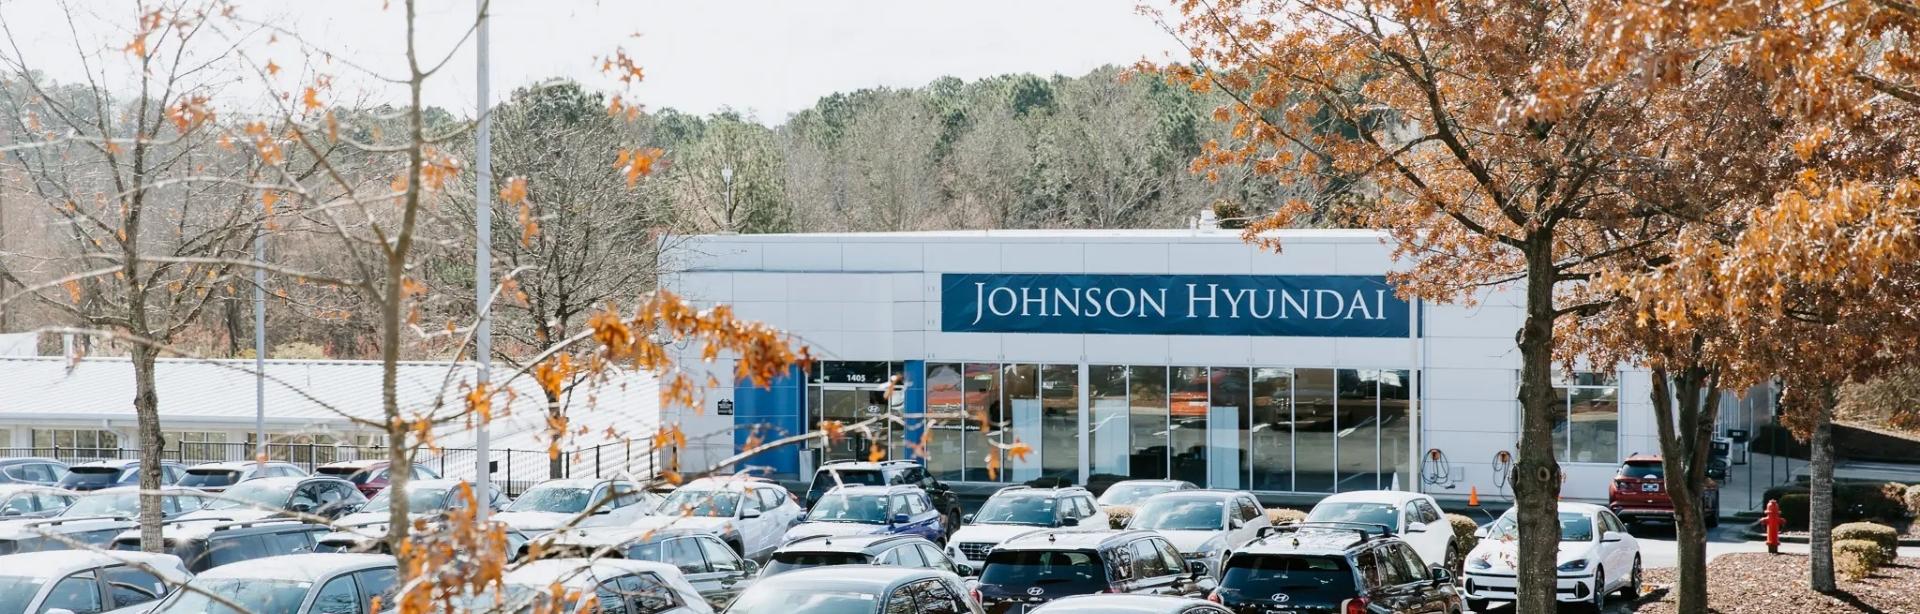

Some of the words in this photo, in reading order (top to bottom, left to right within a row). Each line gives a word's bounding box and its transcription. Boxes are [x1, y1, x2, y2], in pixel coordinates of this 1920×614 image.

[972, 282, 1168, 326] JOHNSON
[1185, 283, 1388, 320] HYUNDAI
[846, 374, 866, 382] 1405
